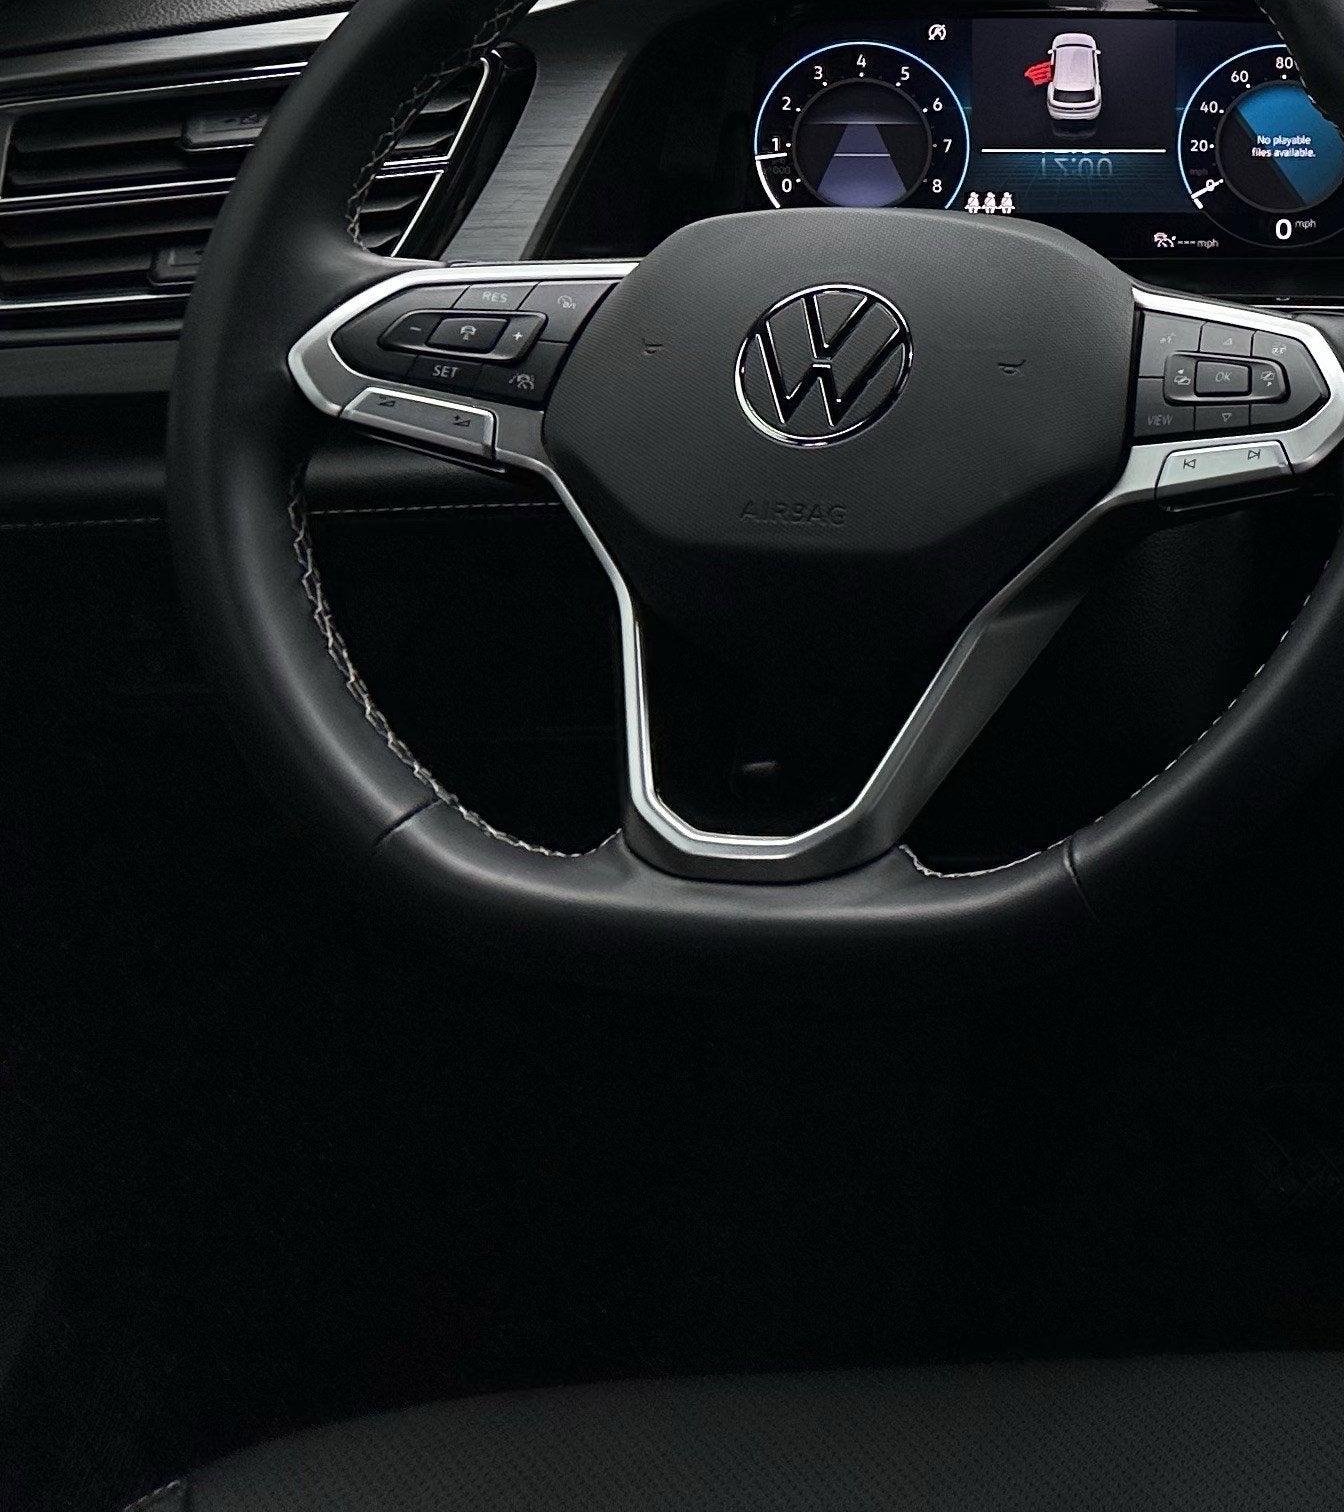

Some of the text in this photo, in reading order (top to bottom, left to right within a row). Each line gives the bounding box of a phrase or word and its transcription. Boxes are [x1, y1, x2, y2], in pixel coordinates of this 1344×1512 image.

[856, 54, 867, 68] 4
[1275, 57, 1294, 69] 80
[813, 65, 823, 80] 3
[900, 67, 910, 81] 5
[1231, 70, 1249, 83] 60
[781, 96, 792, 111] 2
[932, 98, 943, 111] 6
[1200, 101, 1218, 114] 40
[771, 138, 779, 152] 1
[943, 139, 952, 153] 7
[1190, 139, 1208, 152] 20
[1257, 135, 1311, 147] No playable
[1252, 148, 1316, 158] files available.
[781, 178, 792, 193] 0
[932, 179, 942, 193] 8
[1275, 219, 1317, 240] 0 mph
[1197, 238, 1219, 249] mph
[482, 291, 508, 304] RES
[432, 365, 459, 378] SET
[1215, 371, 1233, 383] OK
[1147, 414, 1173, 426] VIEW
[739, 501, 849, 526] AIRBAG
